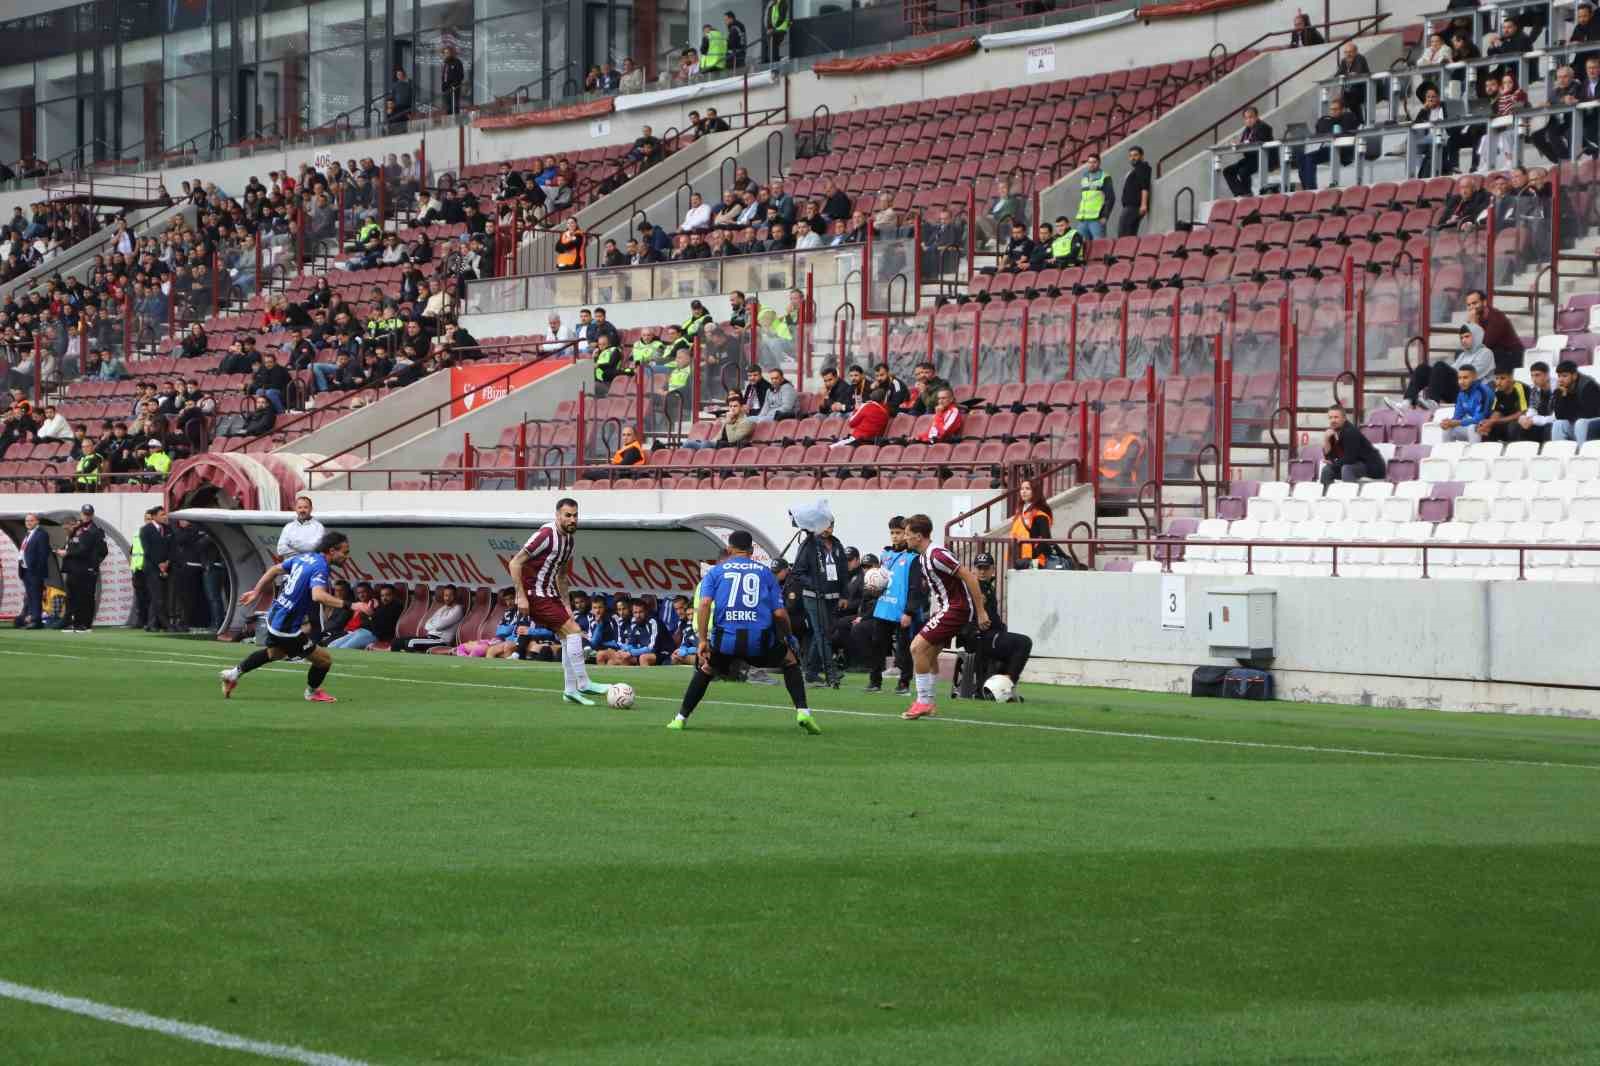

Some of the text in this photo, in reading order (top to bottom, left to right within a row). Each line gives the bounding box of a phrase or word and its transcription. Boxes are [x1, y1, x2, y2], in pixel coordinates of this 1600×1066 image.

[367, 552, 496, 583] HOSPITAL
[724, 571, 760, 608] 79
[1169, 592, 1177, 613] 3
[725, 610, 758, 621] BERKE
